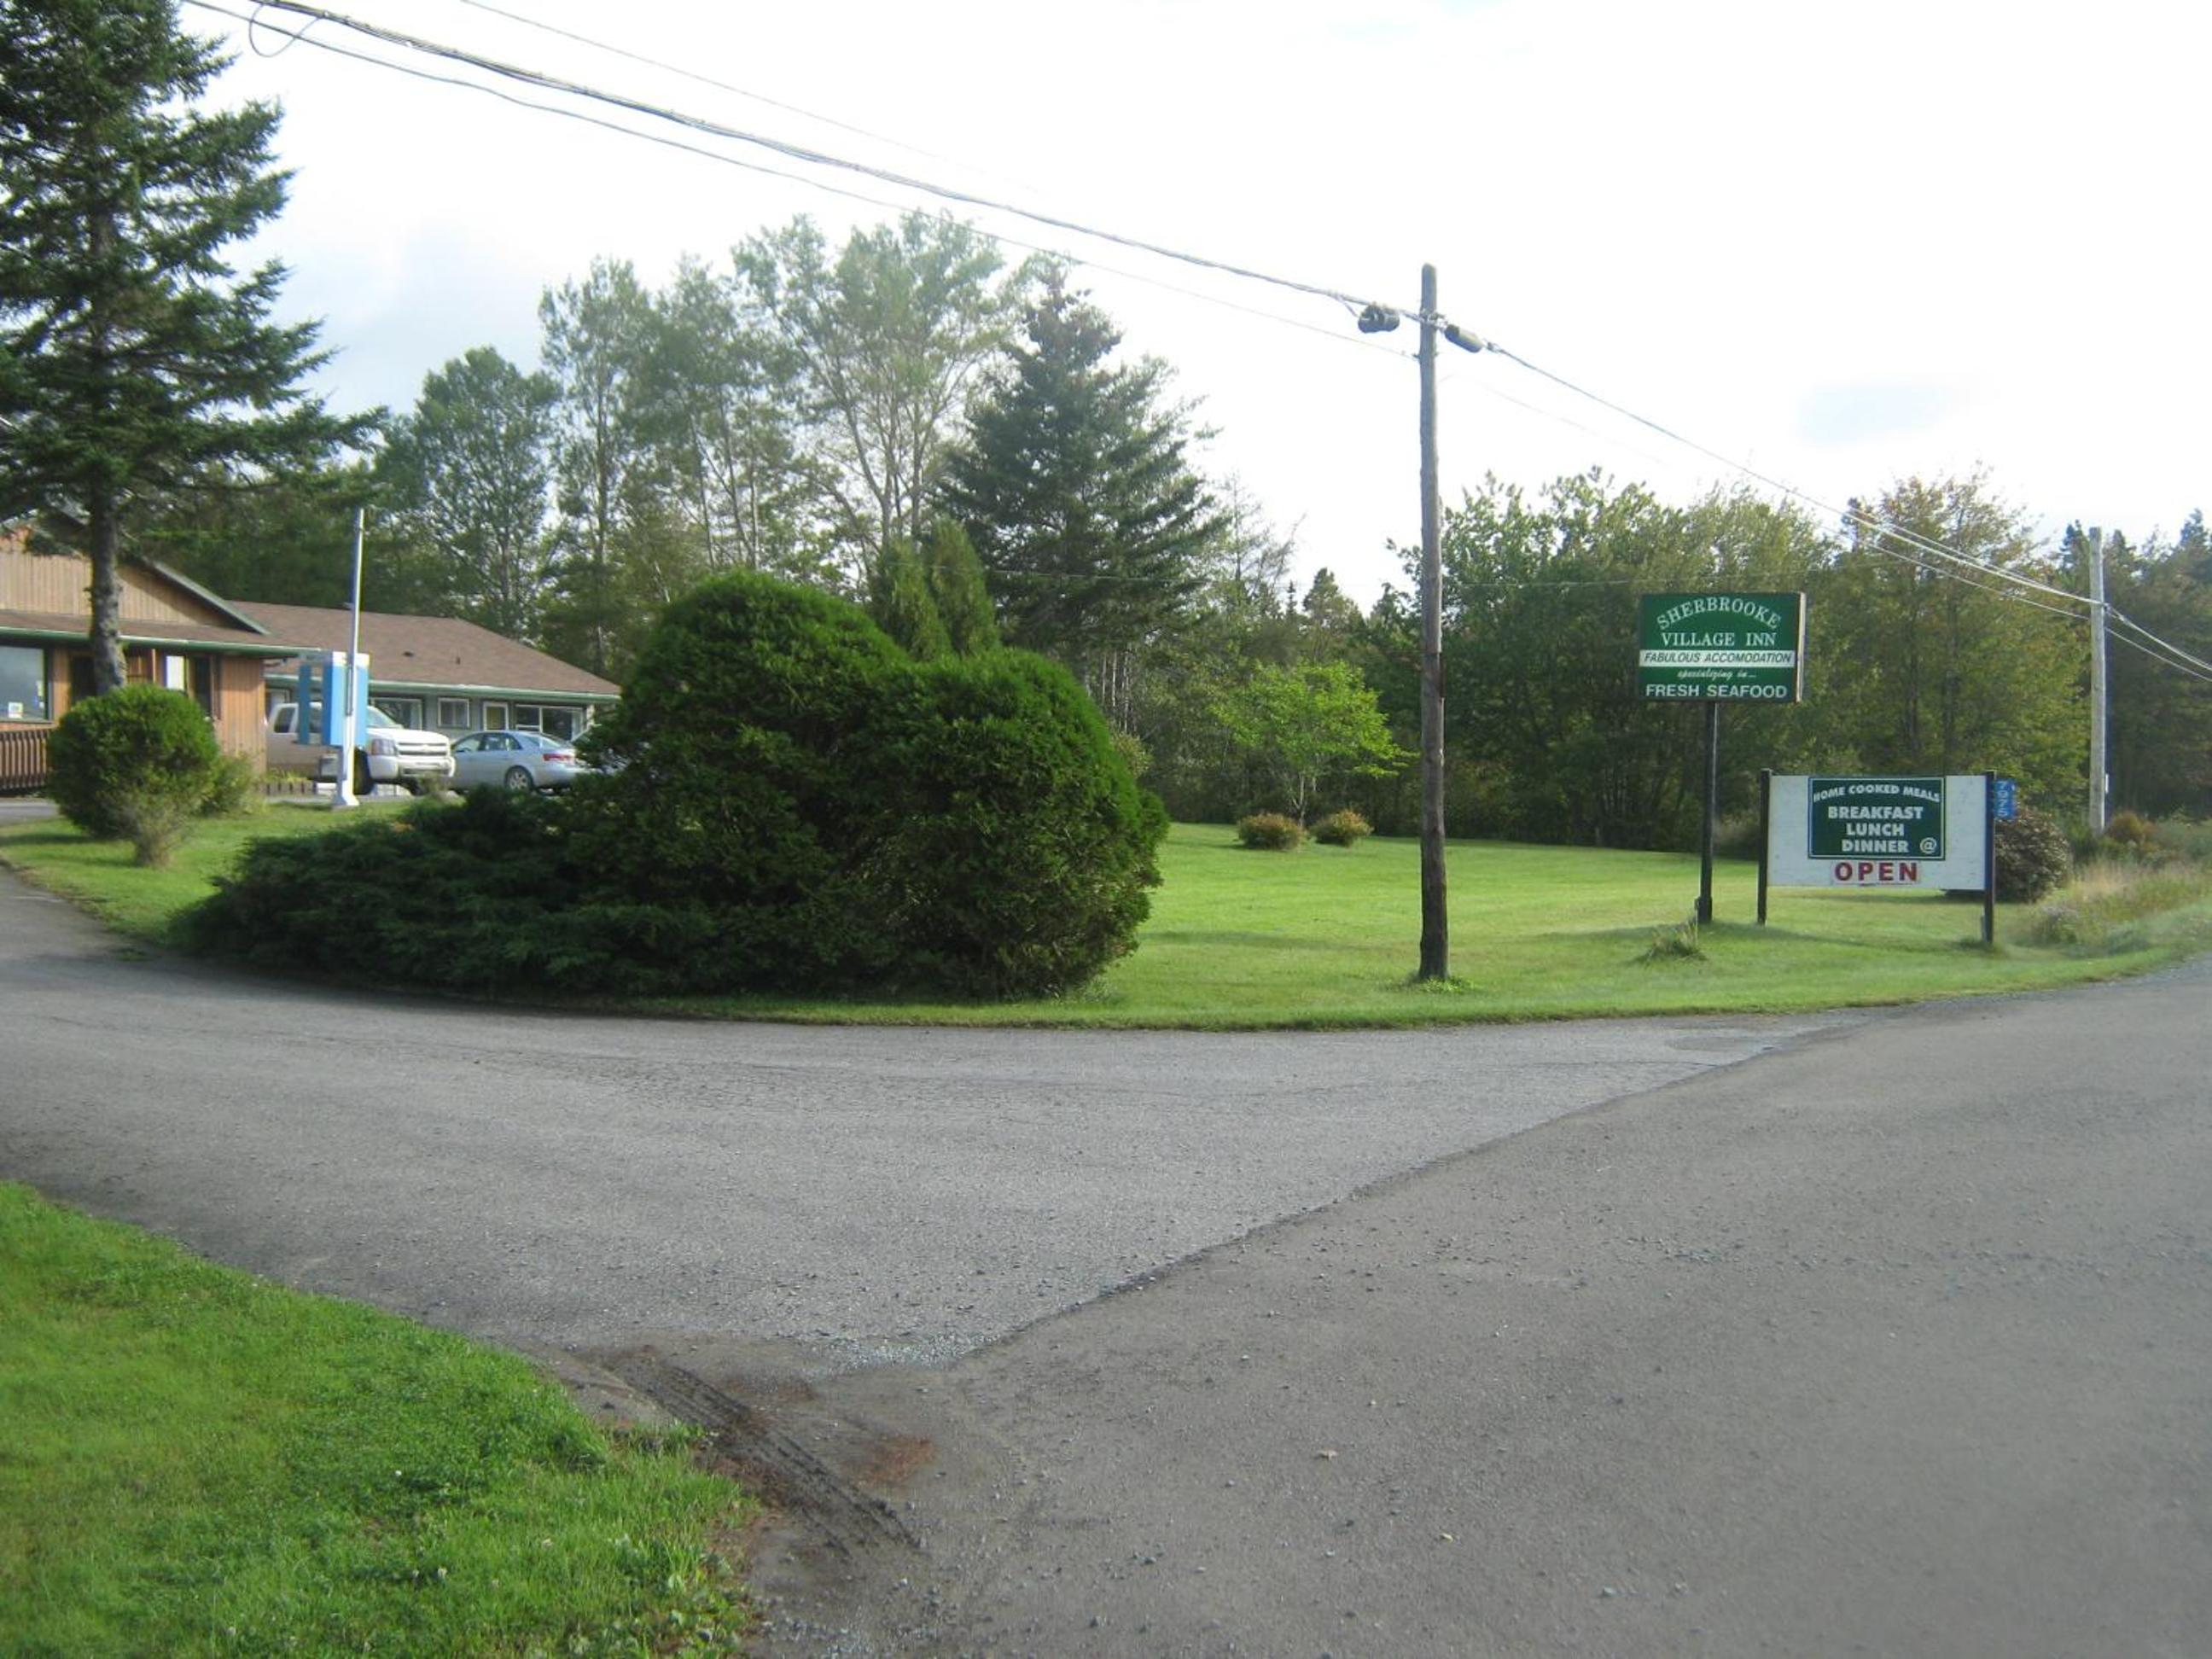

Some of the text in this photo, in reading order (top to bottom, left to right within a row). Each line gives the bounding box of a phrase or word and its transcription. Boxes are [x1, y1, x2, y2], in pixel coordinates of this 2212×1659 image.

[1656, 597, 1782, 630] SHERBROOKE
[1661, 632, 1777, 647] VILLAGE INN
[1644, 652, 1791, 662] FABULOUS ACCOMODATION
[1645, 684, 1787, 698] FRESH SEAFOOD
[1813, 784, 1941, 803] HOME COOKED MEALS
[1828, 806, 1924, 819] BREAKFAST
[1847, 824, 1905, 836] LUNCH
[1842, 840, 1909, 853] DINNER
[1835, 862, 1918, 882] OPEN
